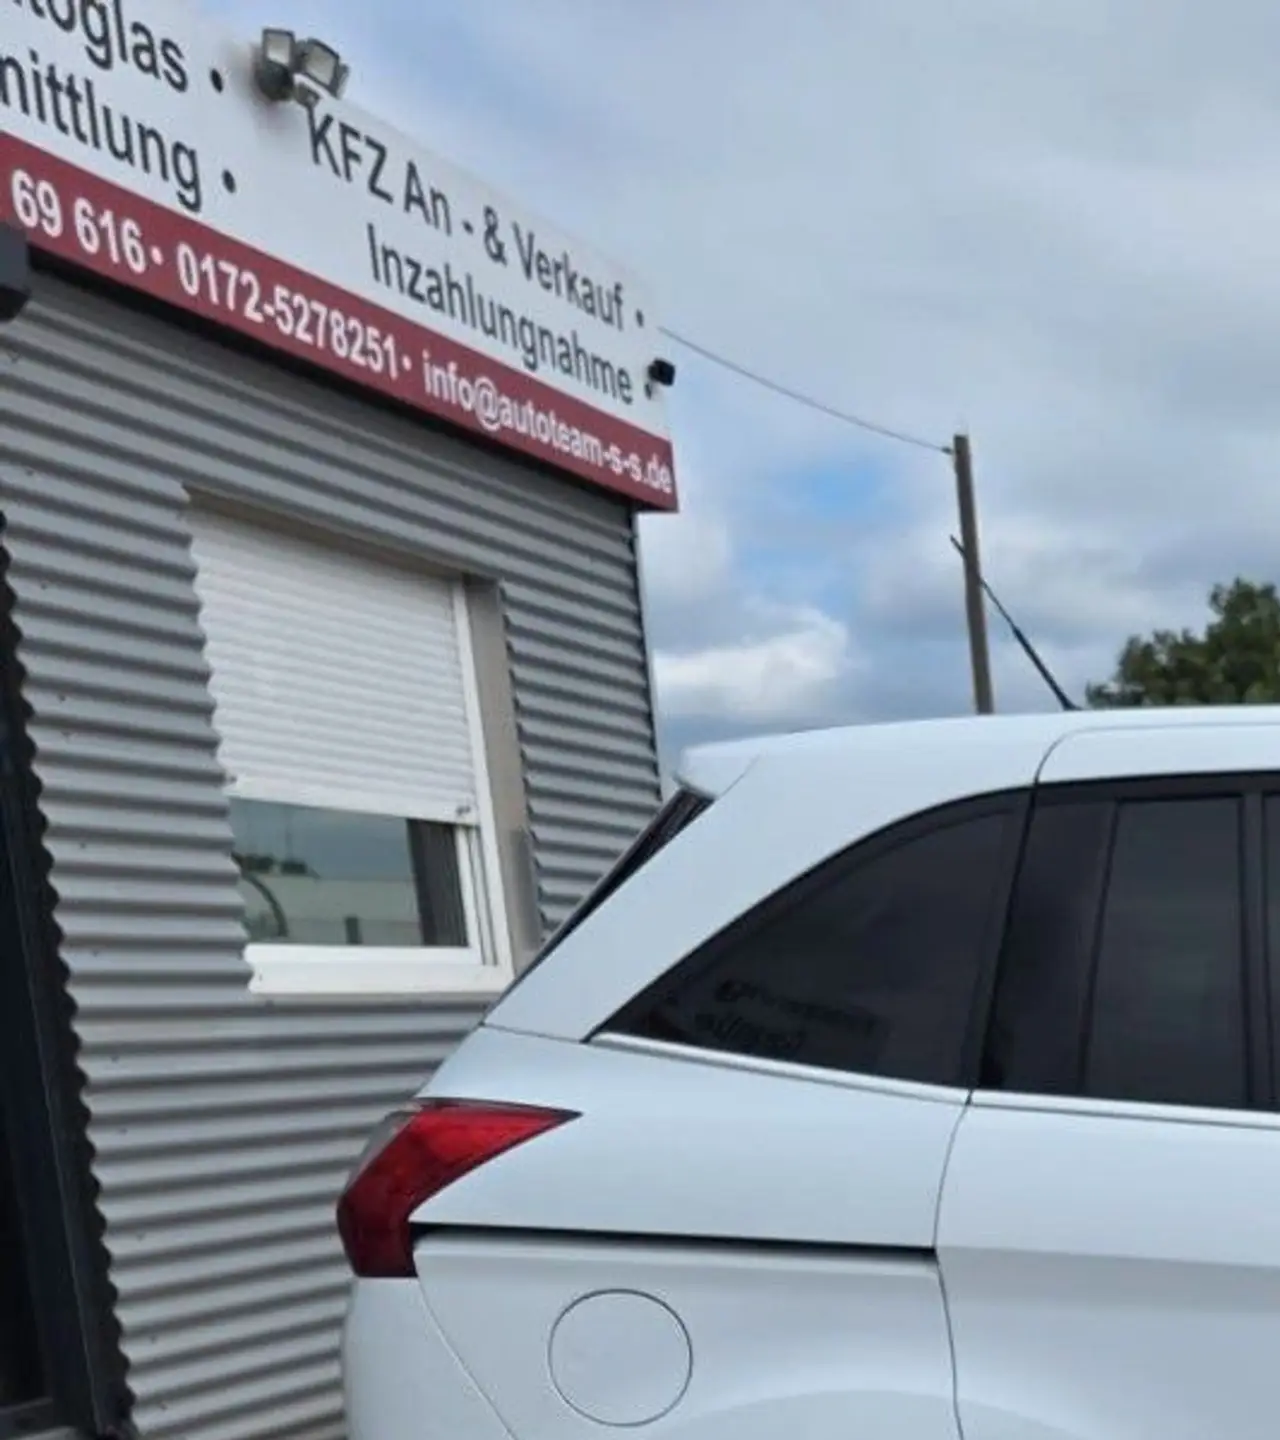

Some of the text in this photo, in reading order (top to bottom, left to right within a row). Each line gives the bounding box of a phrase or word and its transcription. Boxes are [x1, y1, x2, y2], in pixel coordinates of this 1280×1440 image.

[13, 0, 188, 92] oglas
[305, 103, 393, 204] KFZ
[483, 205, 507, 267] &
[512, 222, 624, 331] Verkauf
[367, 222, 634, 404] Inzahlungnahme
[11, 169, 62, 238] 69
[423, 351, 673, 494] info@autoteam-s-s.de
